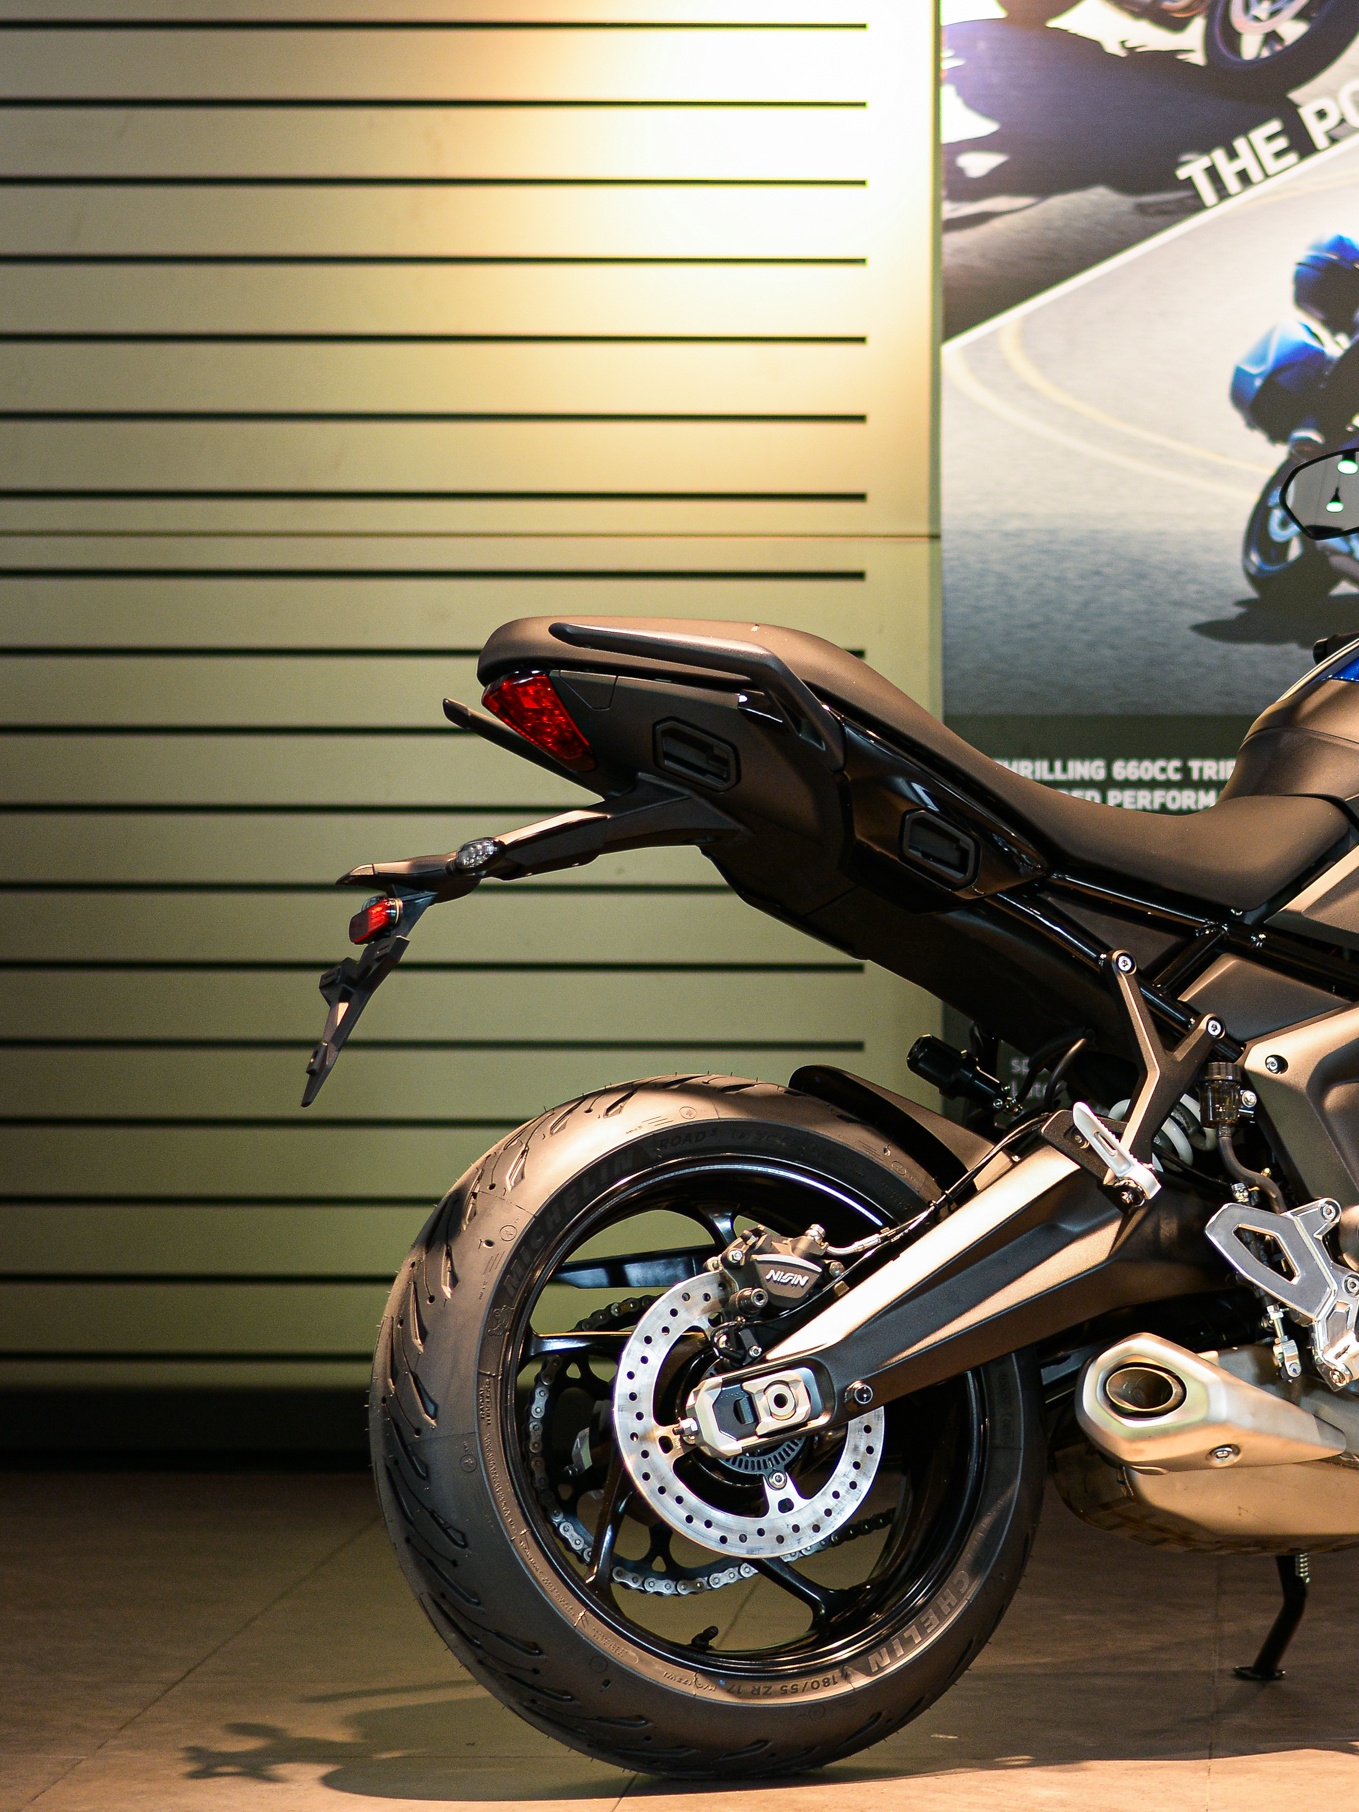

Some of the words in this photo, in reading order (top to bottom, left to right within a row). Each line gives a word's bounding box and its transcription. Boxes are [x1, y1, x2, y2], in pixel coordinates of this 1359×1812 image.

[1175, 118, 1299, 209] THE
[1112, 759, 1182, 781] 660CC
[503, 1150, 635, 1298] MICHELIN
[726, 1683, 742, 1695] 17
[750, 1683, 773, 1696] ZR
[779, 1674, 838, 1694] 180/55
